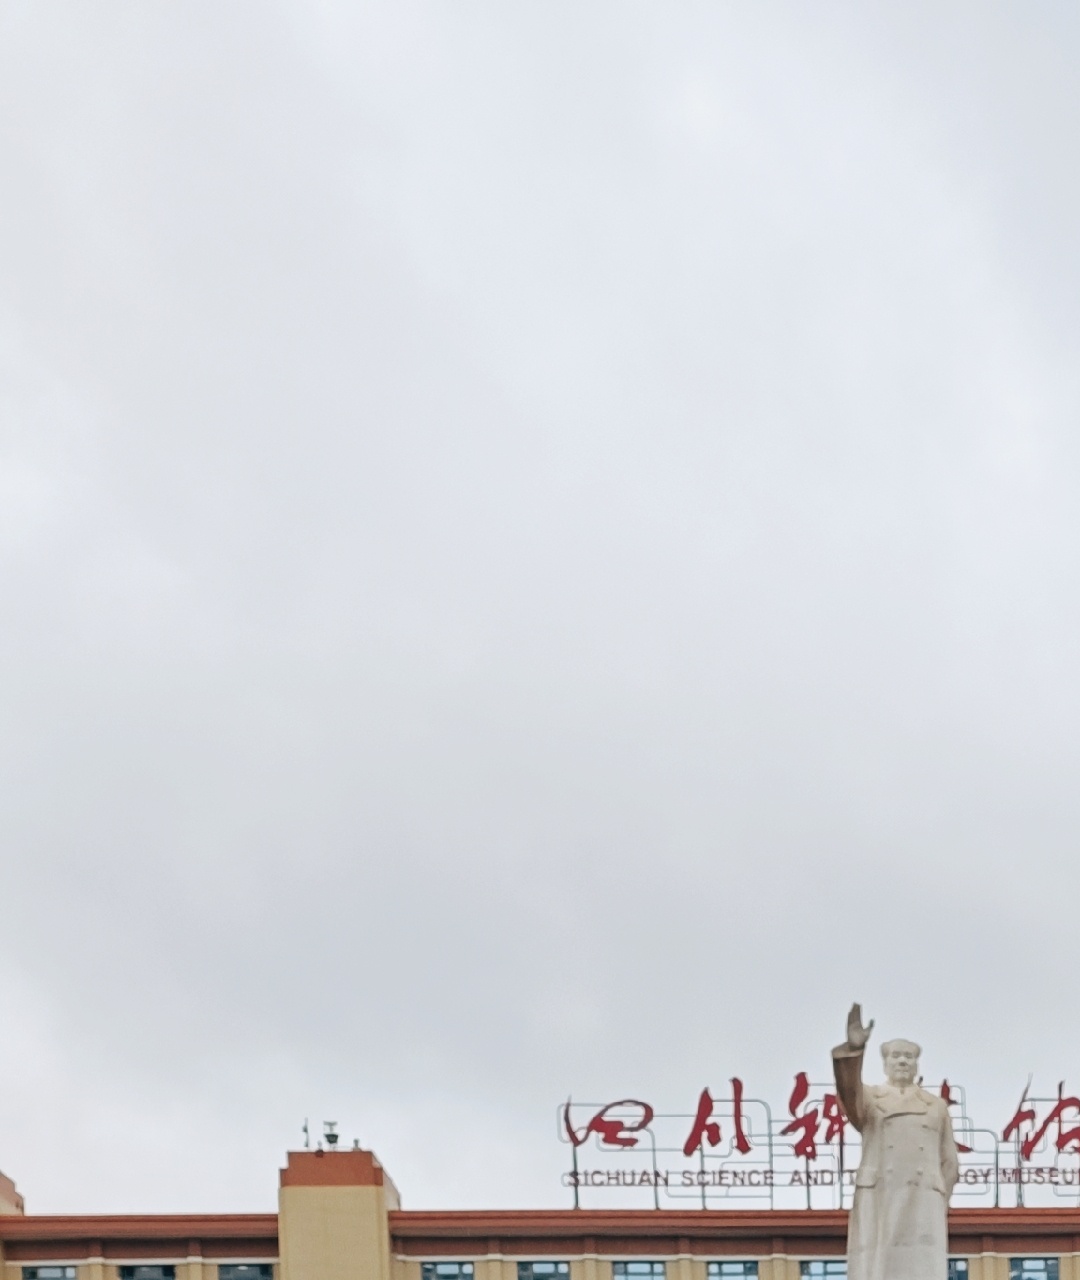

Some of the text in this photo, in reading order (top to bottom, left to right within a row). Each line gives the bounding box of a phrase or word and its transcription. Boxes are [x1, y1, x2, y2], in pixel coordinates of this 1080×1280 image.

[568, 1169, 669, 1187] SICHUAN
[681, 1169, 774, 1187] SCIENCE
[788, 1168, 835, 1186] AND
